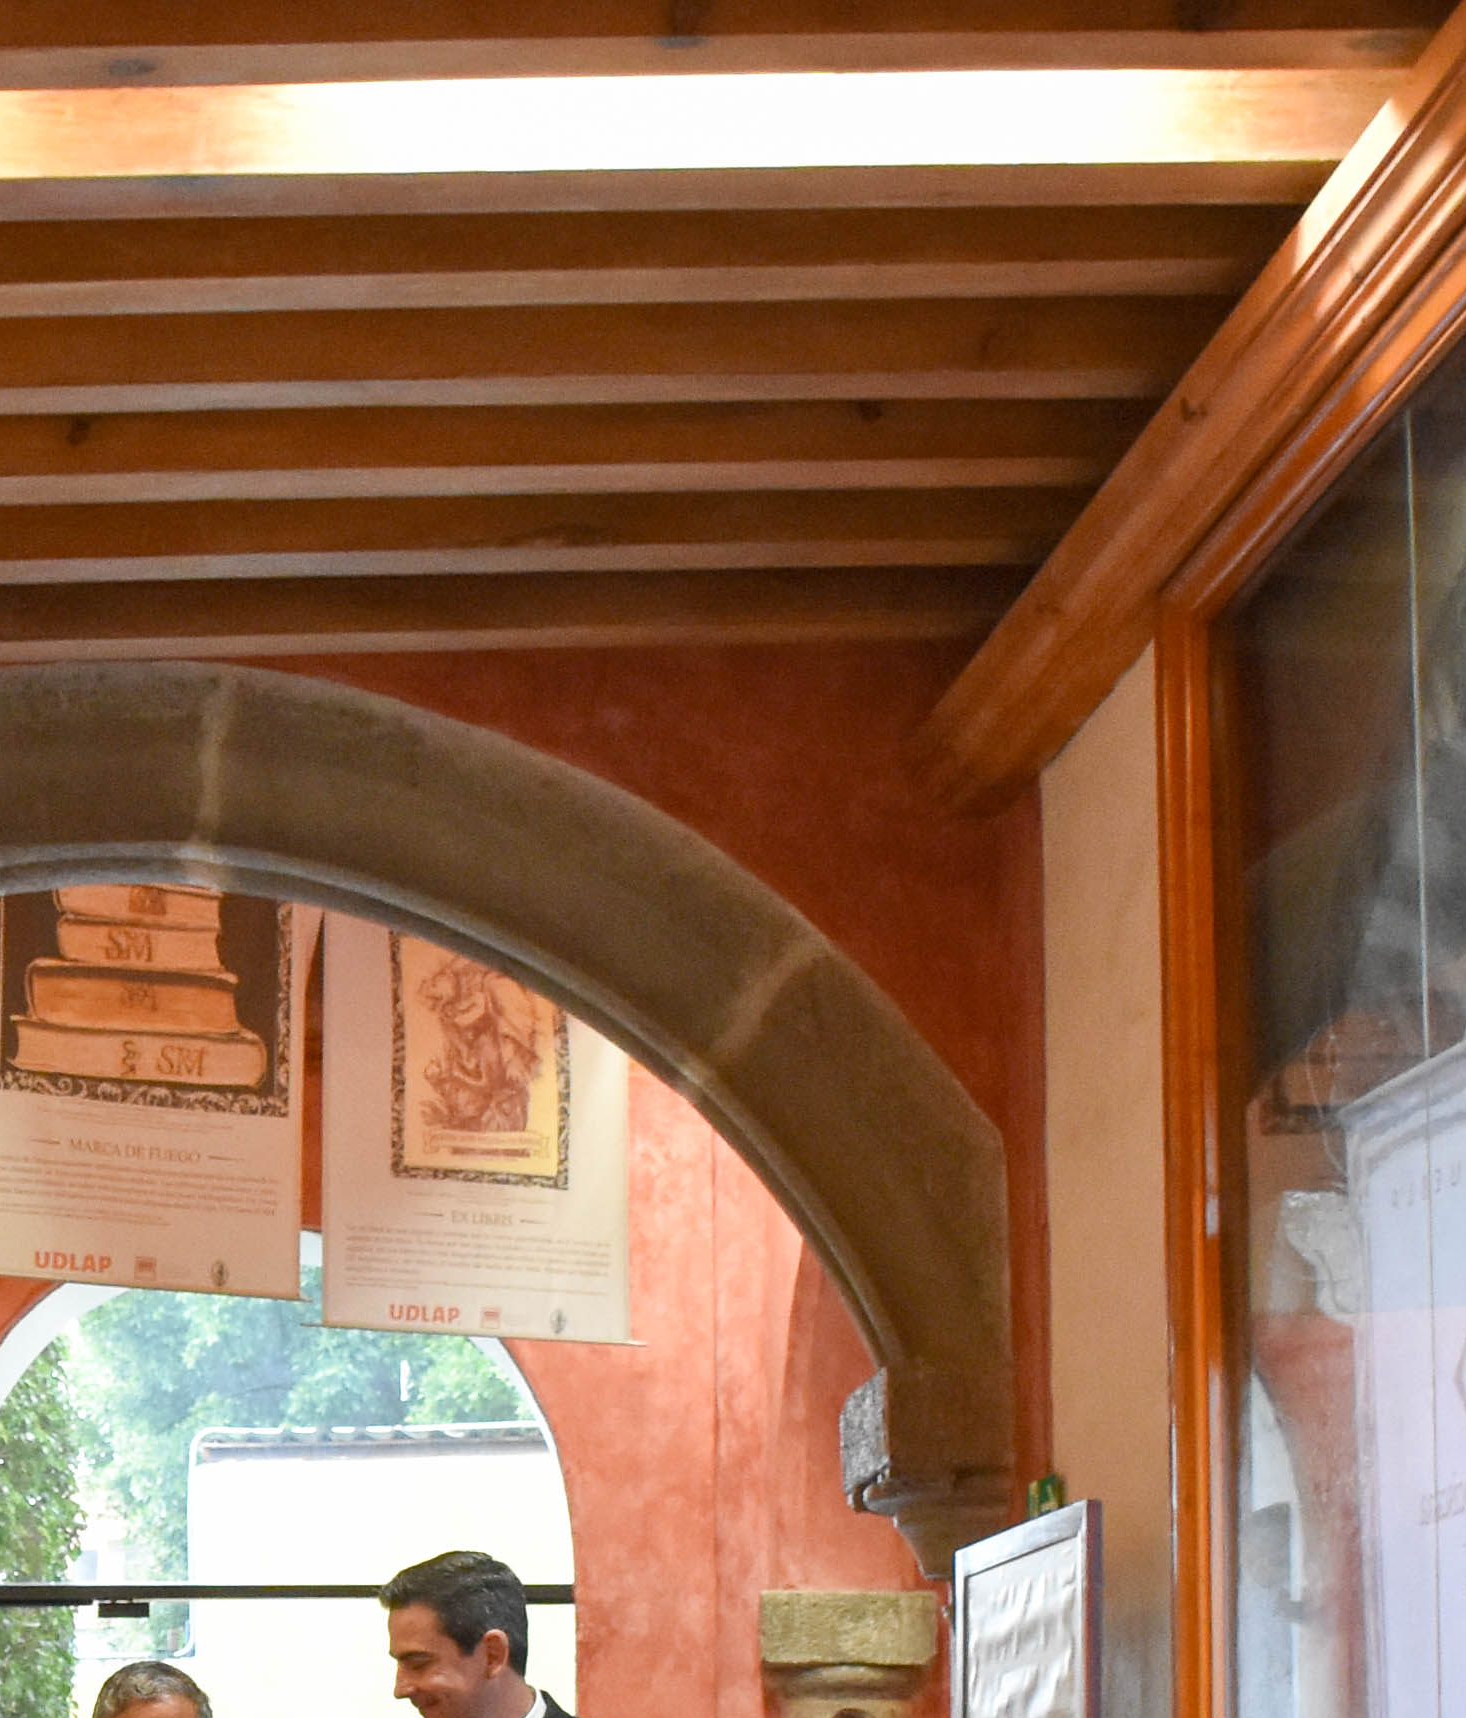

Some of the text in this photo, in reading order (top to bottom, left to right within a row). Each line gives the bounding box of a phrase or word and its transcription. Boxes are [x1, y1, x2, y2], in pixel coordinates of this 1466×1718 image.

[69, 1137, 201, 1162] MARCA DE FUEGO
[451, 1209, 471, 1224] EX
[34, 1251, 113, 1272] UDLAP
[389, 1303, 461, 1323] UDLAP
